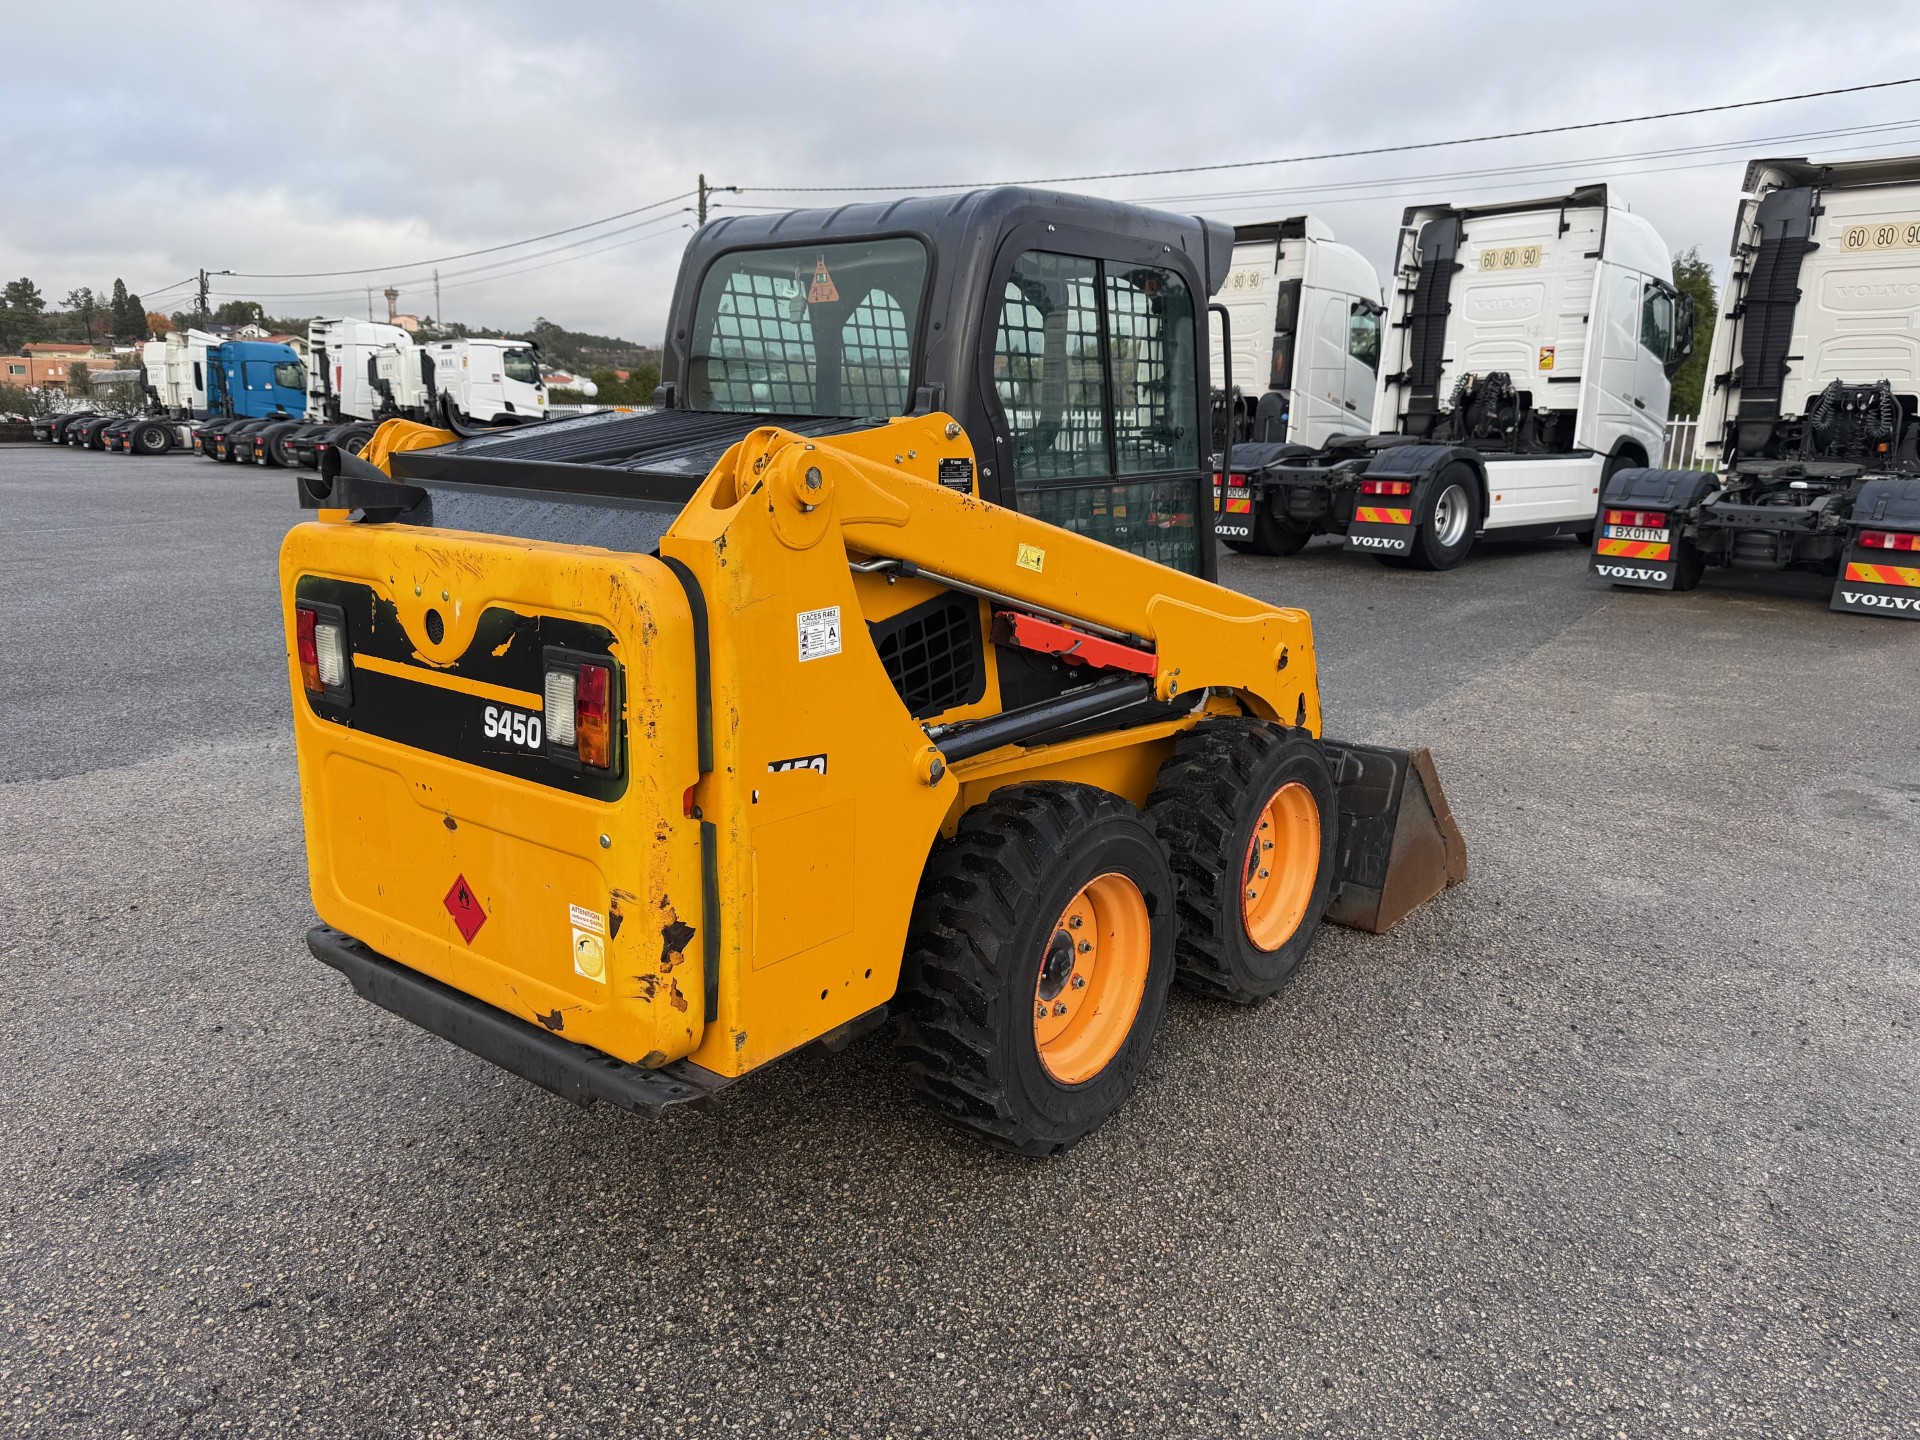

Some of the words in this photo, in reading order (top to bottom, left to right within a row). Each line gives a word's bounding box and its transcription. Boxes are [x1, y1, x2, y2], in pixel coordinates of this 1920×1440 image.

[1848, 229, 1865, 247] 60
[1877, 227, 1894, 245] 80
[1483, 252, 1496, 267] 60
[1503, 250, 1516, 266] 80
[1523, 249, 1536, 264] 90
[1834, 283, 1920, 298] VOLVO
[1215, 525, 1249, 536] OLVO
[1615, 527, 1663, 541] BX01TN
[1350, 535, 1405, 549] VOLVO
[1595, 564, 1667, 581] VOLVO
[801, 612, 822, 623] CACES
[829, 626, 836, 639] A
[484, 705, 542, 749] S450
[571, 905, 600, 921] ATTENTION
